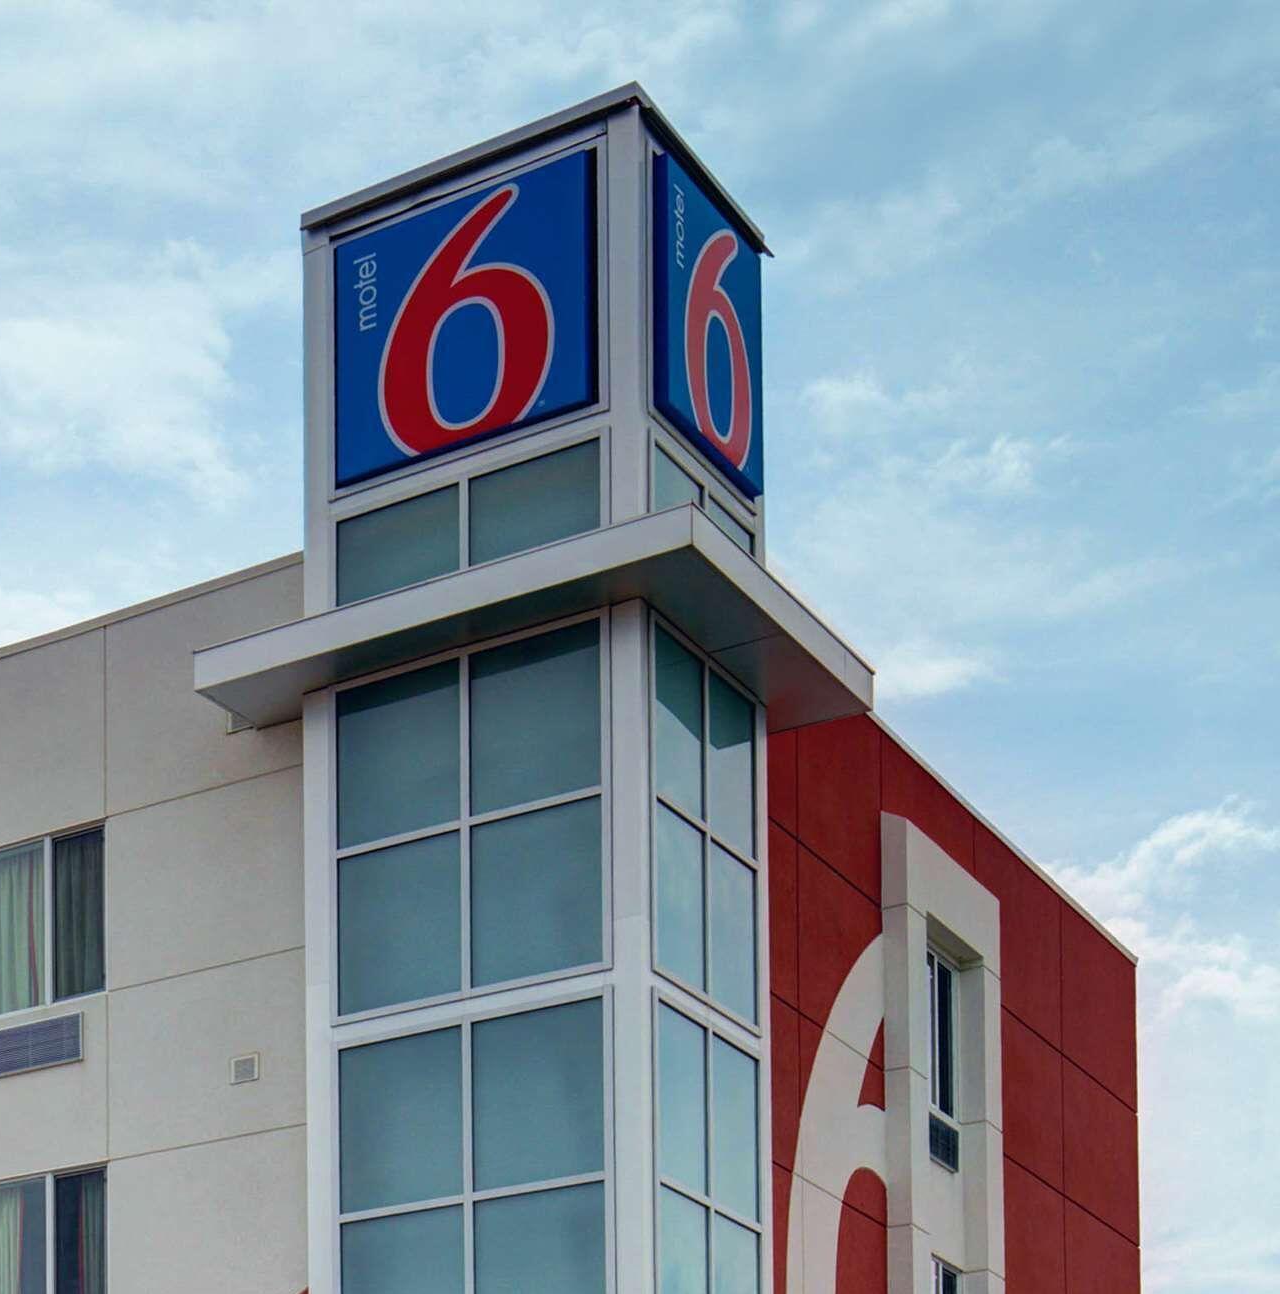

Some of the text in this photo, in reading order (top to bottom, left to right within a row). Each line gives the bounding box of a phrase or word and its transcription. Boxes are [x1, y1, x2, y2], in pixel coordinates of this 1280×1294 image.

[352, 252, 377, 332] motel
[673, 183, 685, 269] motel
[377, 182, 556, 458] 6
[684, 228, 753, 472] 6
